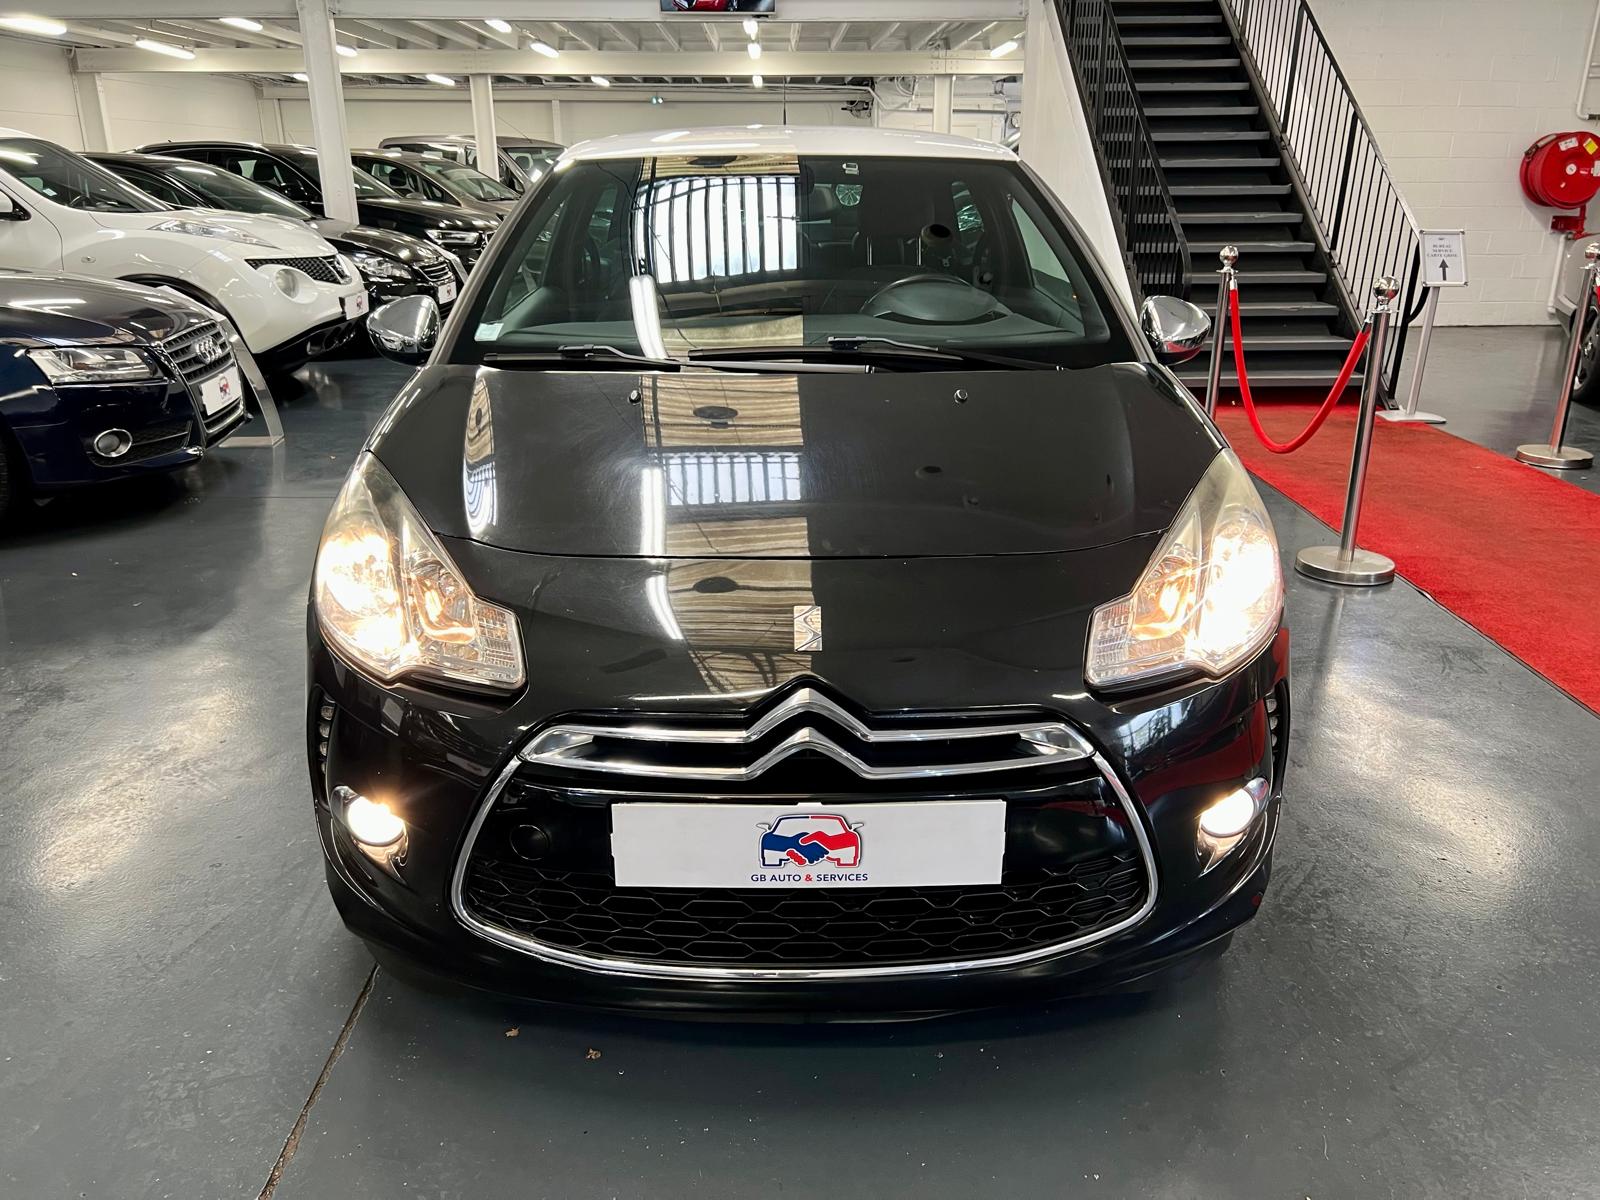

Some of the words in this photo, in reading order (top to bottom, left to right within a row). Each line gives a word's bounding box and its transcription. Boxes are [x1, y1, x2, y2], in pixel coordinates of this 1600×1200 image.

[750, 874, 767, 882] GB
[769, 874, 802, 882] AUTO
[804, 873, 813, 882] &
[816, 873, 869, 882] SERVICES
